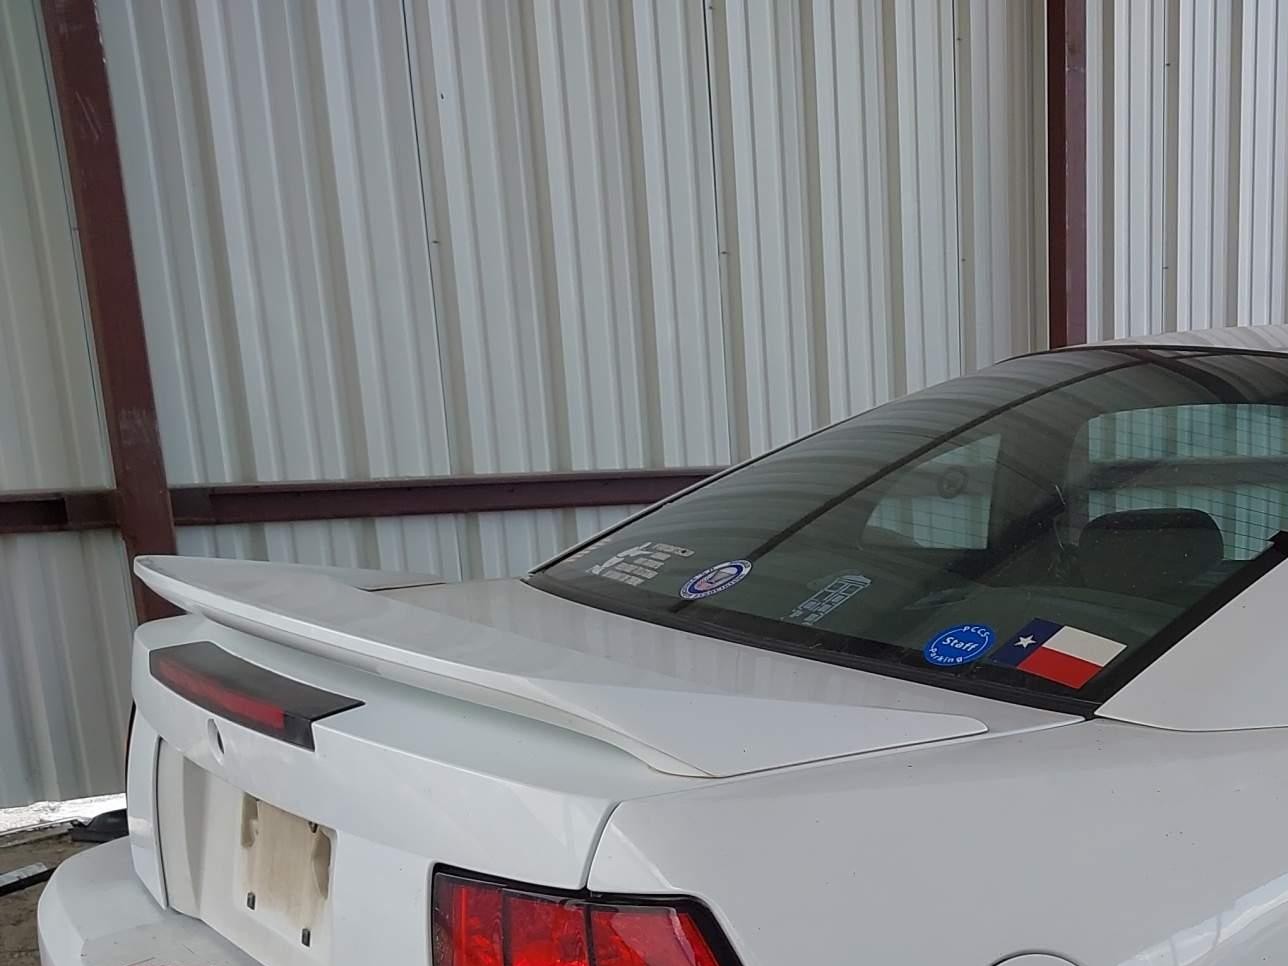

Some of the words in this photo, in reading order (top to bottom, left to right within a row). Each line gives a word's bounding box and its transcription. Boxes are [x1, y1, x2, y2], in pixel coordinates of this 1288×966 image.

[962, 625, 990, 638] PCCS
[942, 636, 980, 652] Staff
[928, 647, 963, 664] Parking
